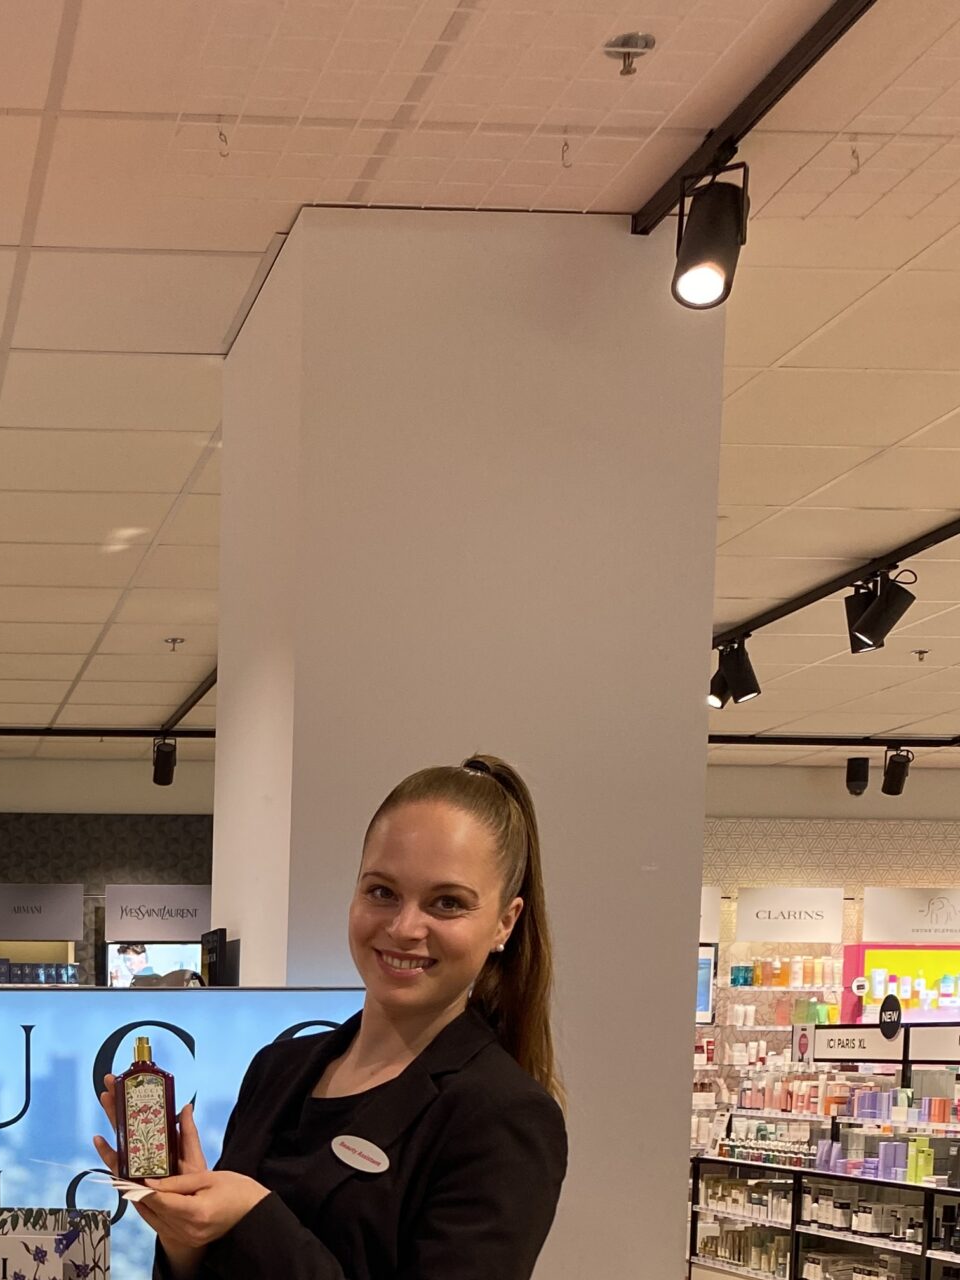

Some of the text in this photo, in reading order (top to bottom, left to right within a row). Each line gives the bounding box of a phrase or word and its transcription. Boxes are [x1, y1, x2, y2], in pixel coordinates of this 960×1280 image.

[11, 905, 42, 914] ARMANI
[755, 909, 825, 921] CLARINS
[881, 1010, 899, 1022] NEW
[827, 1038, 866, 1049] ICI PARIS XL
